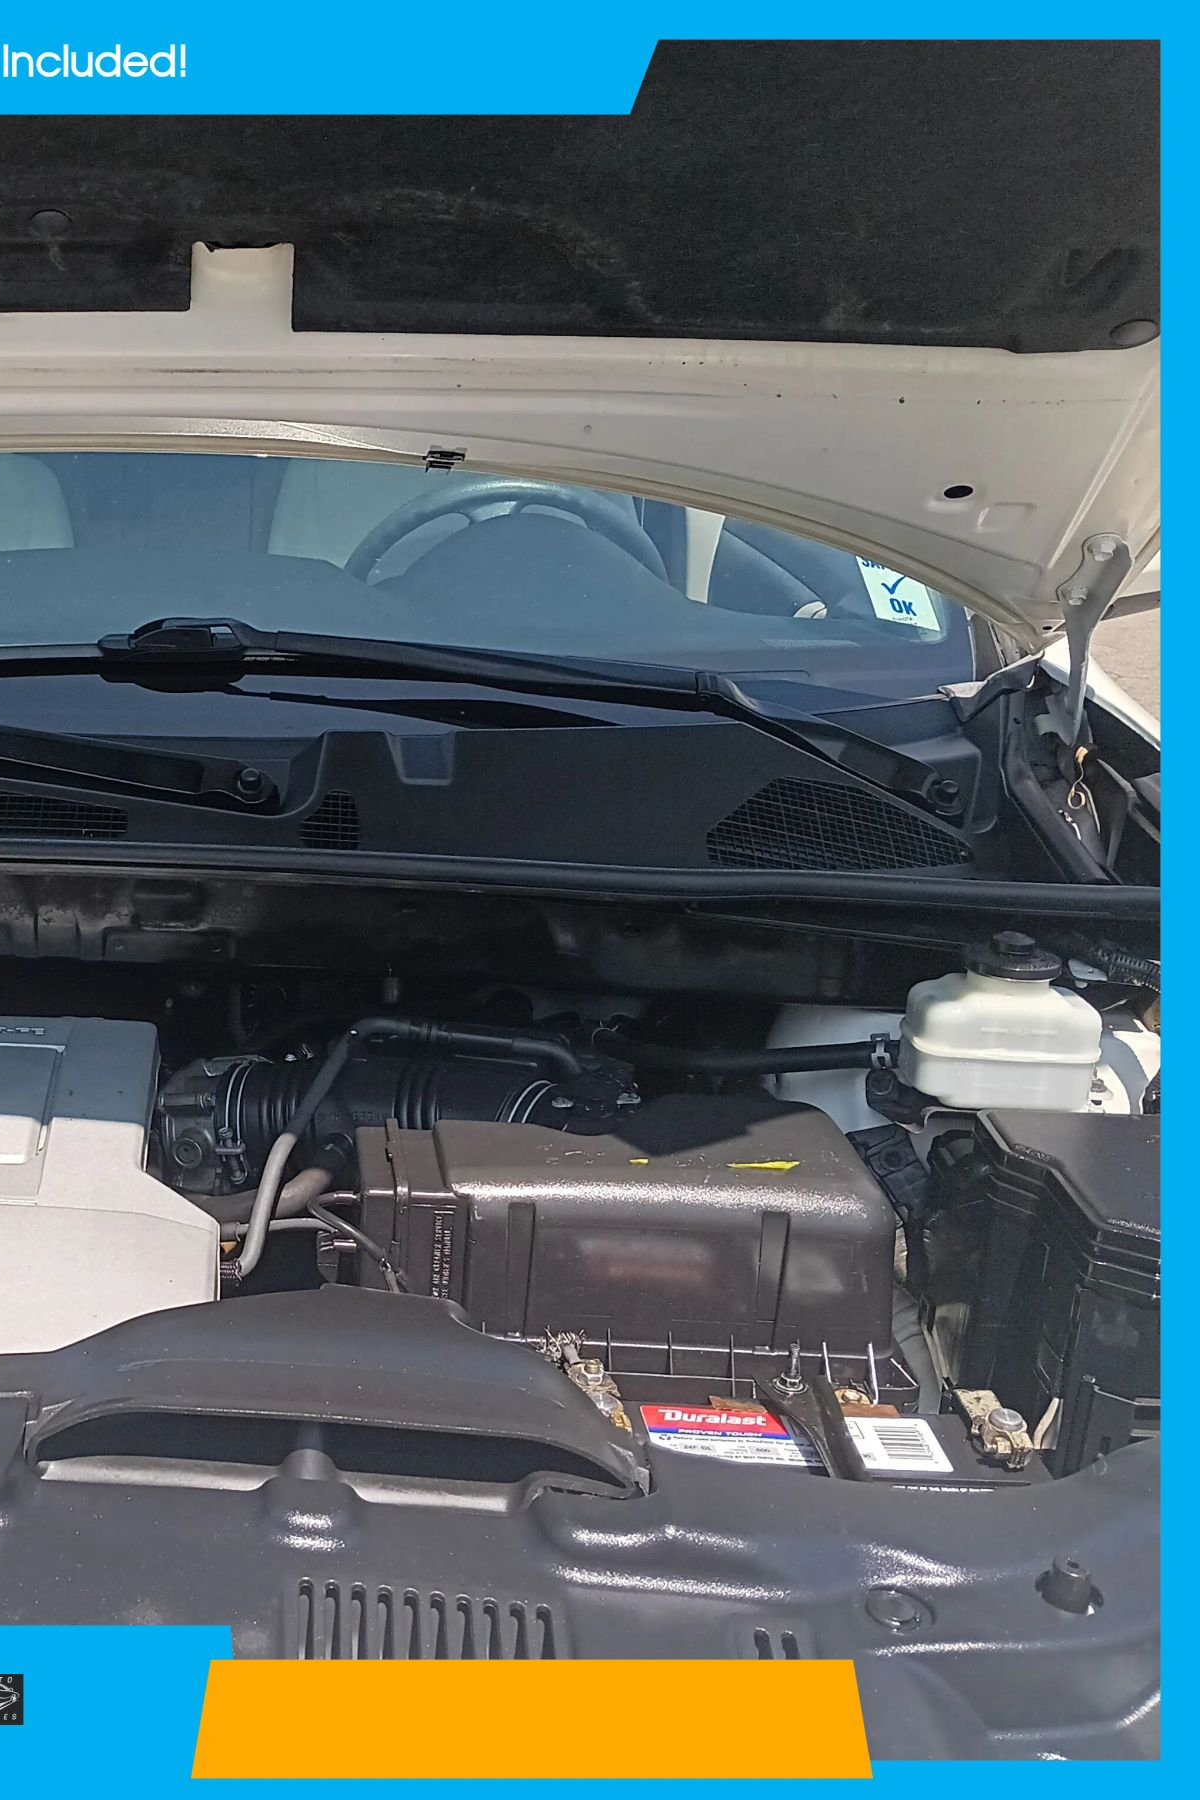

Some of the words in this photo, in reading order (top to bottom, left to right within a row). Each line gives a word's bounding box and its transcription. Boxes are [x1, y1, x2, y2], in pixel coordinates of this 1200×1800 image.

[889, 598, 917, 617] OK
[657, 1408, 768, 1427] Duralast
[677, 1428, 722, 1436] PROVEN
